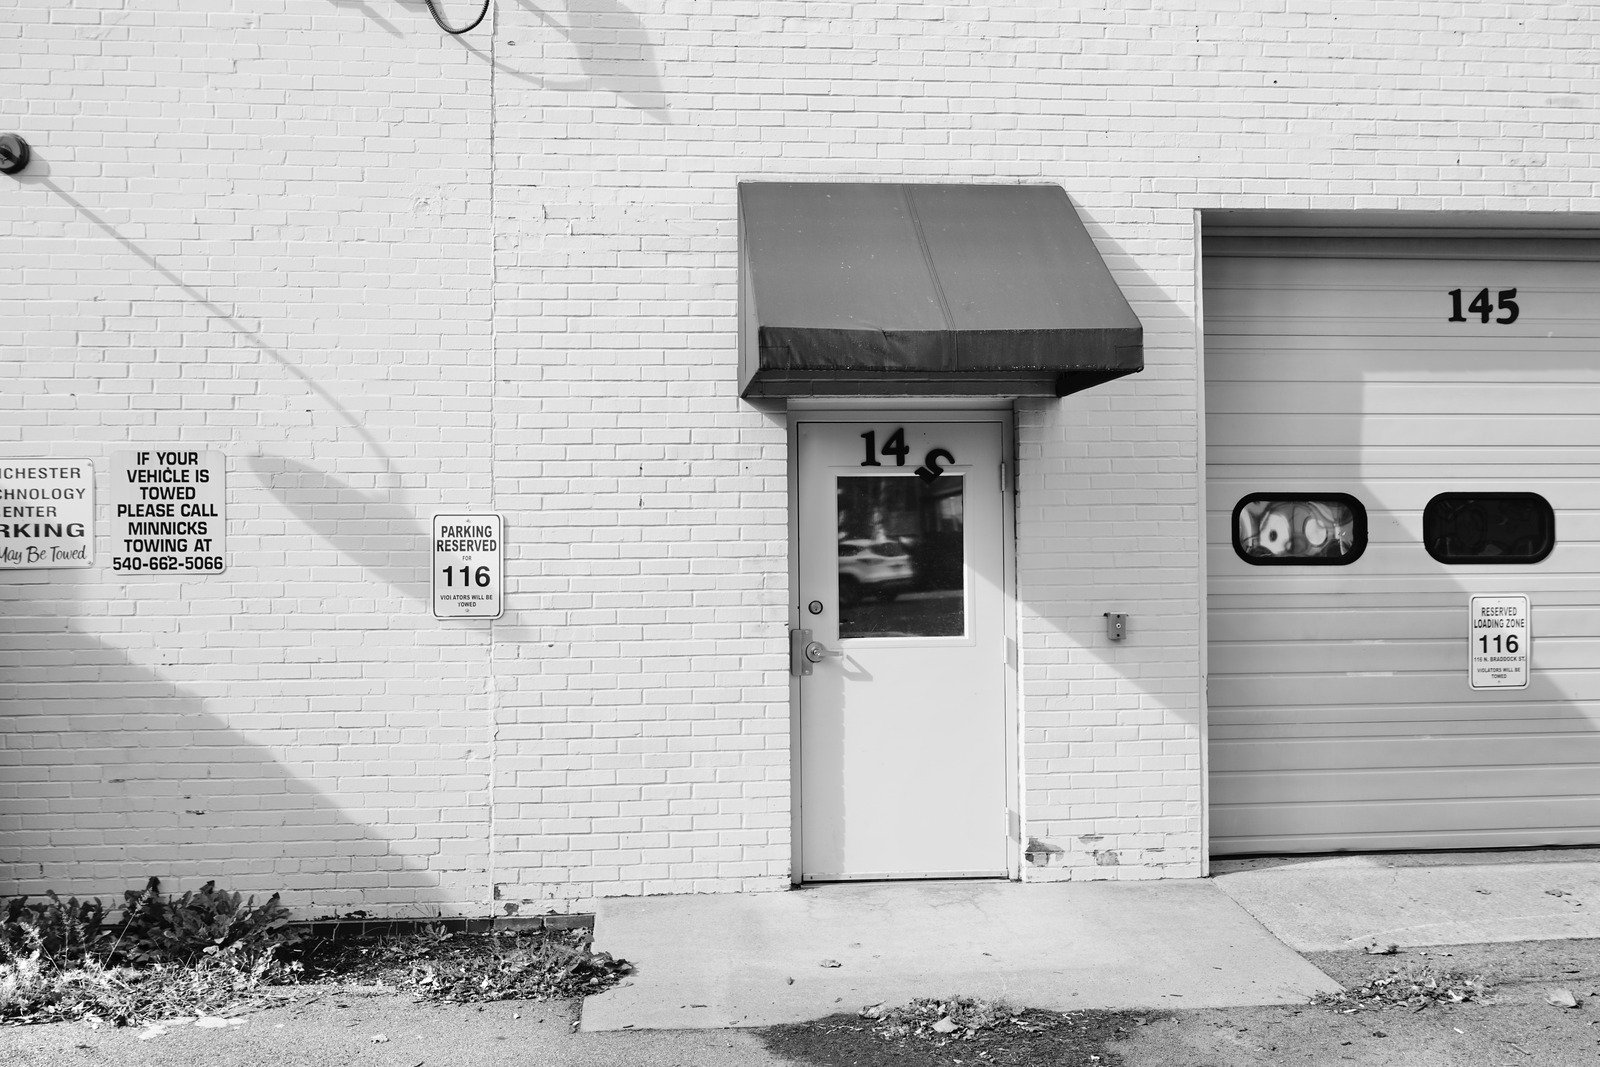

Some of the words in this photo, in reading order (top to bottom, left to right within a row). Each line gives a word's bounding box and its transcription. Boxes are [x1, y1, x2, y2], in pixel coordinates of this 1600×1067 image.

[1448, 287, 1519, 325] 145
[137, 452, 150, 465] IF
[156, 452, 198, 466] YOUR
[0, 467, 81, 479] CHESTER
[127, 469, 189, 483] VEHICLE
[195, 469, 210, 483] IS
[0, 488, 86, 500] HNOLOGY
[140, 487, 196, 500] TOWED
[117, 504, 175, 517] PLEASE
[181, 504, 218, 517] CALL
[128, 521, 207, 535] MINNICKS
[441, 526, 492, 538] PARKING
[124, 539, 187, 553] TOWING
[194, 539, 212, 553] AT
[437, 540, 497, 552] RESERVED
[26, 546, 47, 563] Be
[50, 545, 87, 562] Towed
[113, 556, 223, 570] 540-662-5066
[443, 565, 491, 587] 116
[1481, 607, 1517, 616] RESERVED
[1474, 619, 1504, 628] LOADING
[1506, 619, 1525, 628] ZONE
[1479, 634, 1519, 653] 116
